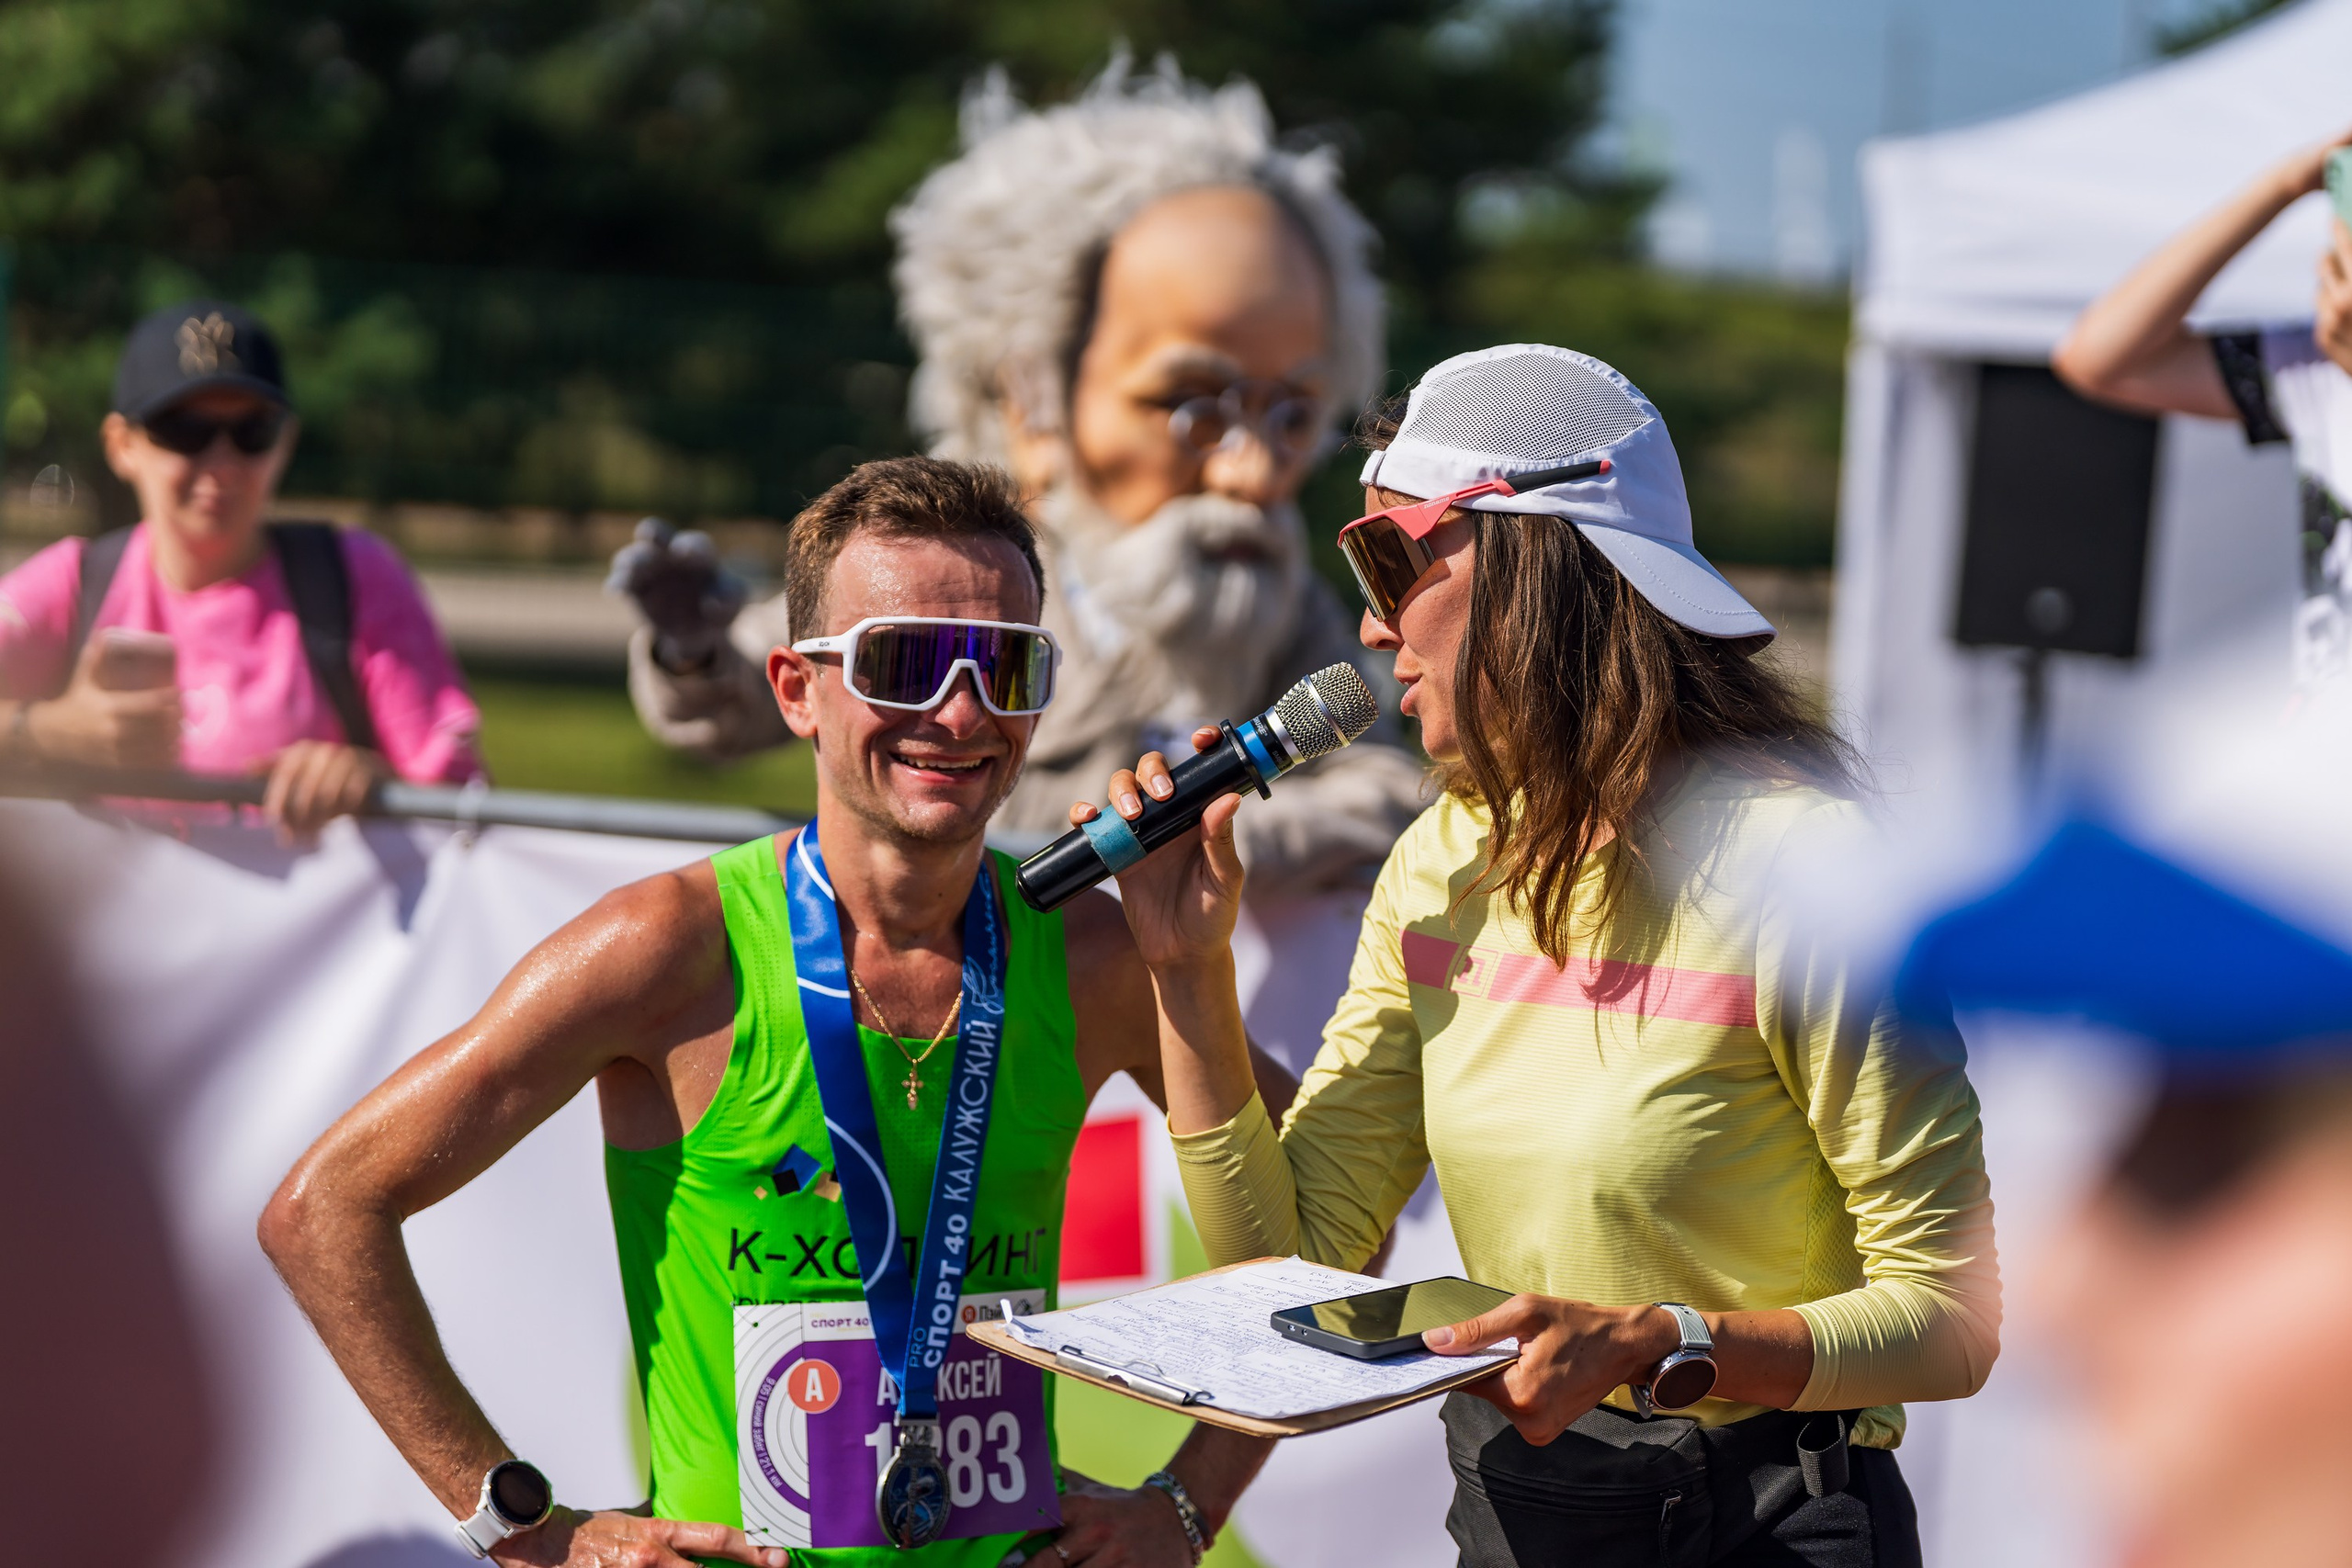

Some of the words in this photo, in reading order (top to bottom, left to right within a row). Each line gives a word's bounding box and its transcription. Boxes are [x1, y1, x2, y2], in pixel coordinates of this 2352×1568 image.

[943, 1020, 998, 1202] КАЛУЖСКИЙ
[944, 1213, 968, 1256] 40
[811, 1318, 851, 1328] СПОРТ
[854, 1317, 869, 1326] 40
[923, 1259, 963, 1369] СПОРТ
[909, 1327, 928, 1368] PRO
[876, 1352, 1002, 1406] АКСЕЙ
